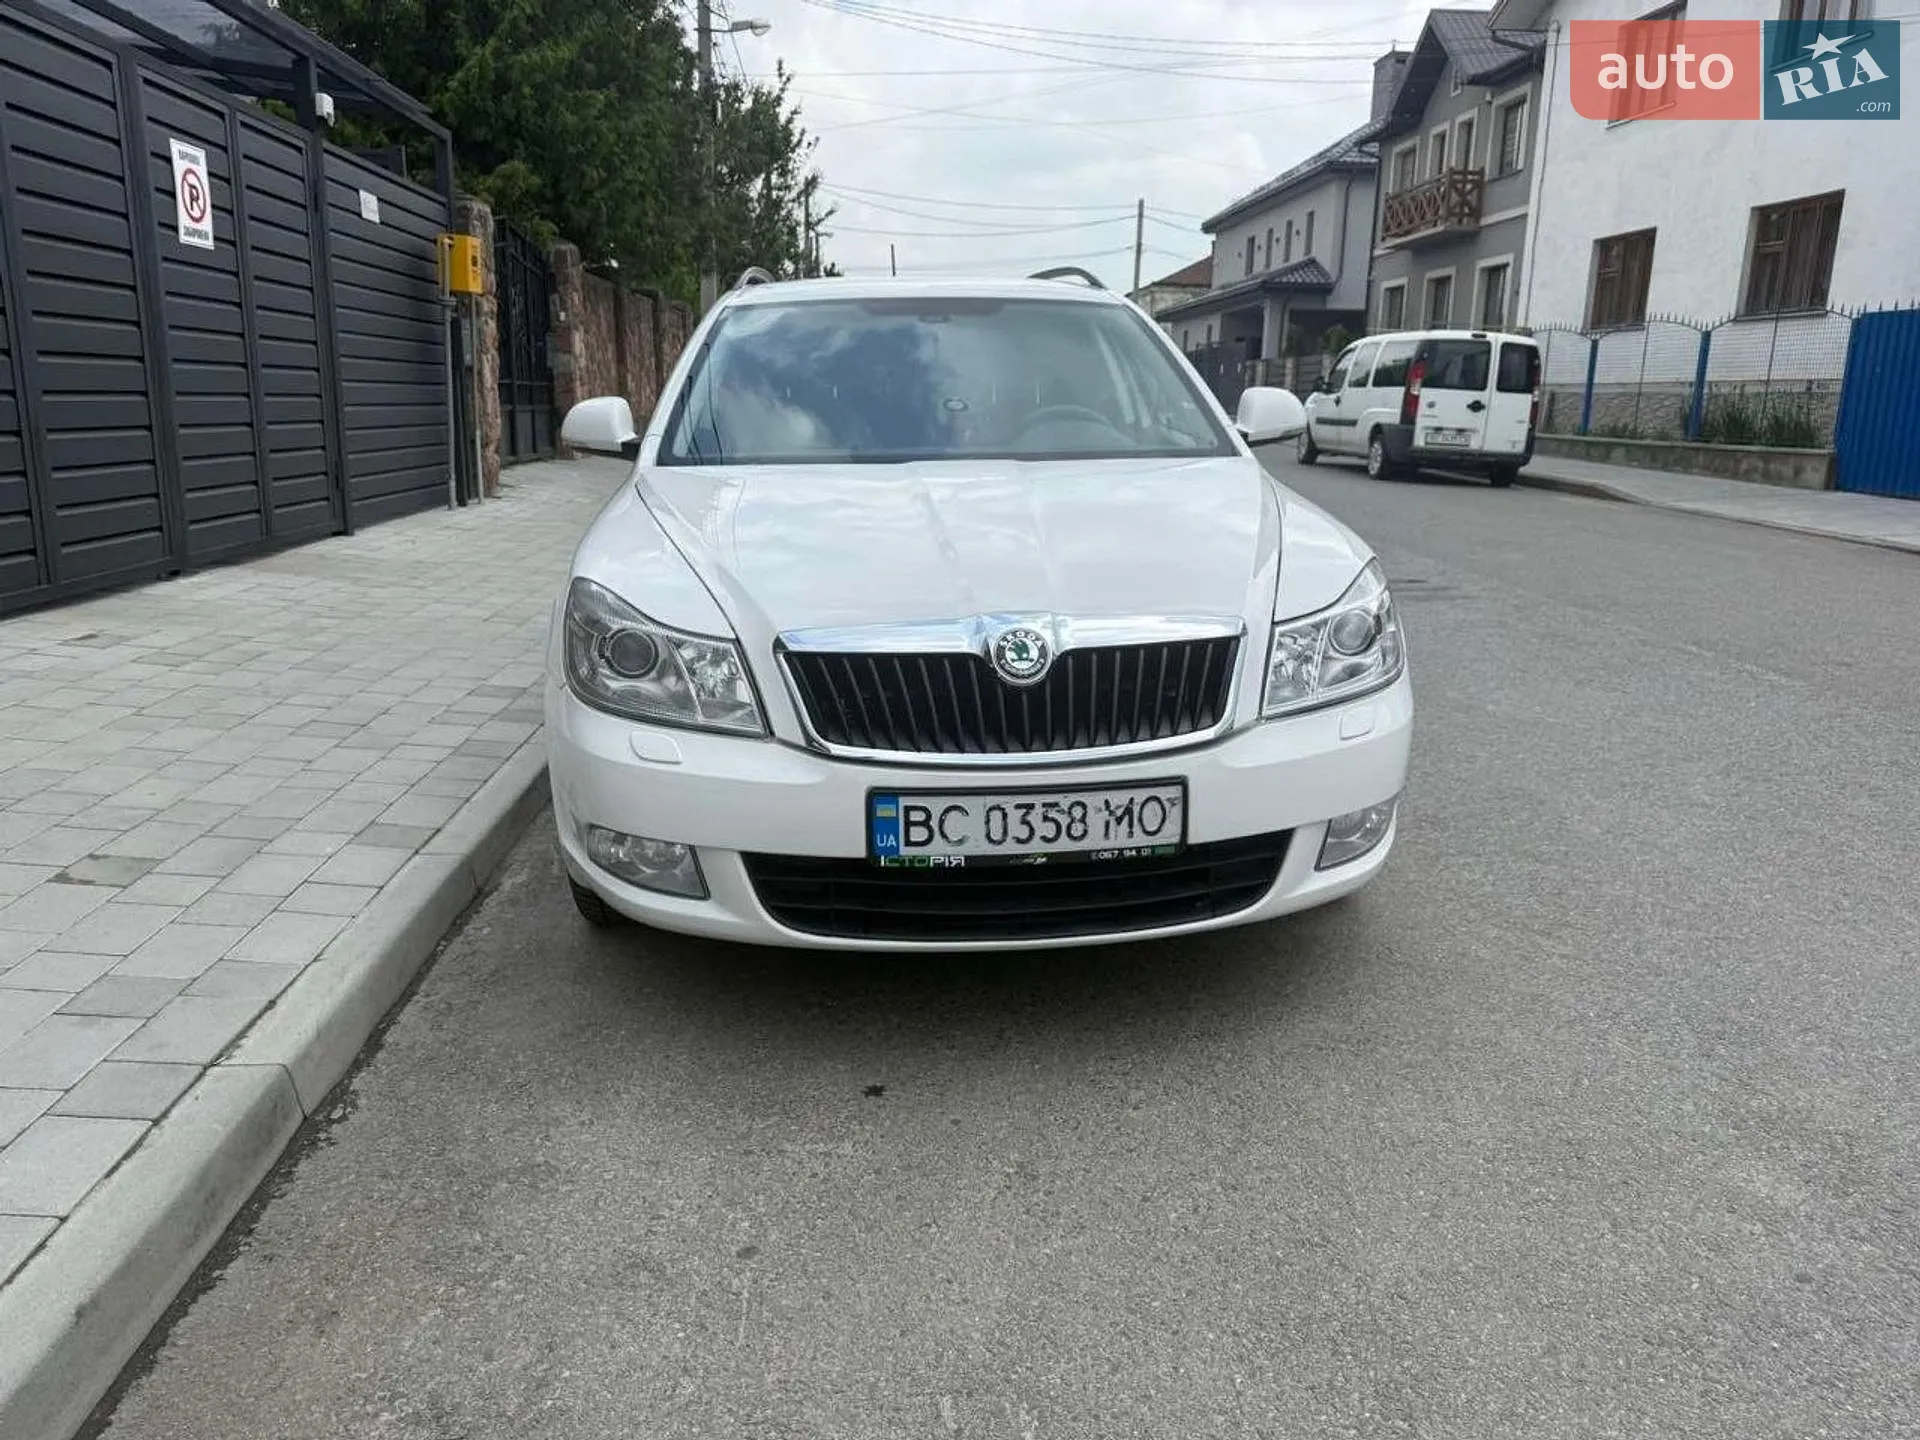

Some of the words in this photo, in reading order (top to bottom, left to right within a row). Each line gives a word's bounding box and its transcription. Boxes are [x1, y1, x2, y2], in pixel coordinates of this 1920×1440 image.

[903, 804, 970, 847] BC
[984, 801, 1089, 845] 0358
[1103, 795, 1167, 840] MO
[876, 836, 897, 848] UA
